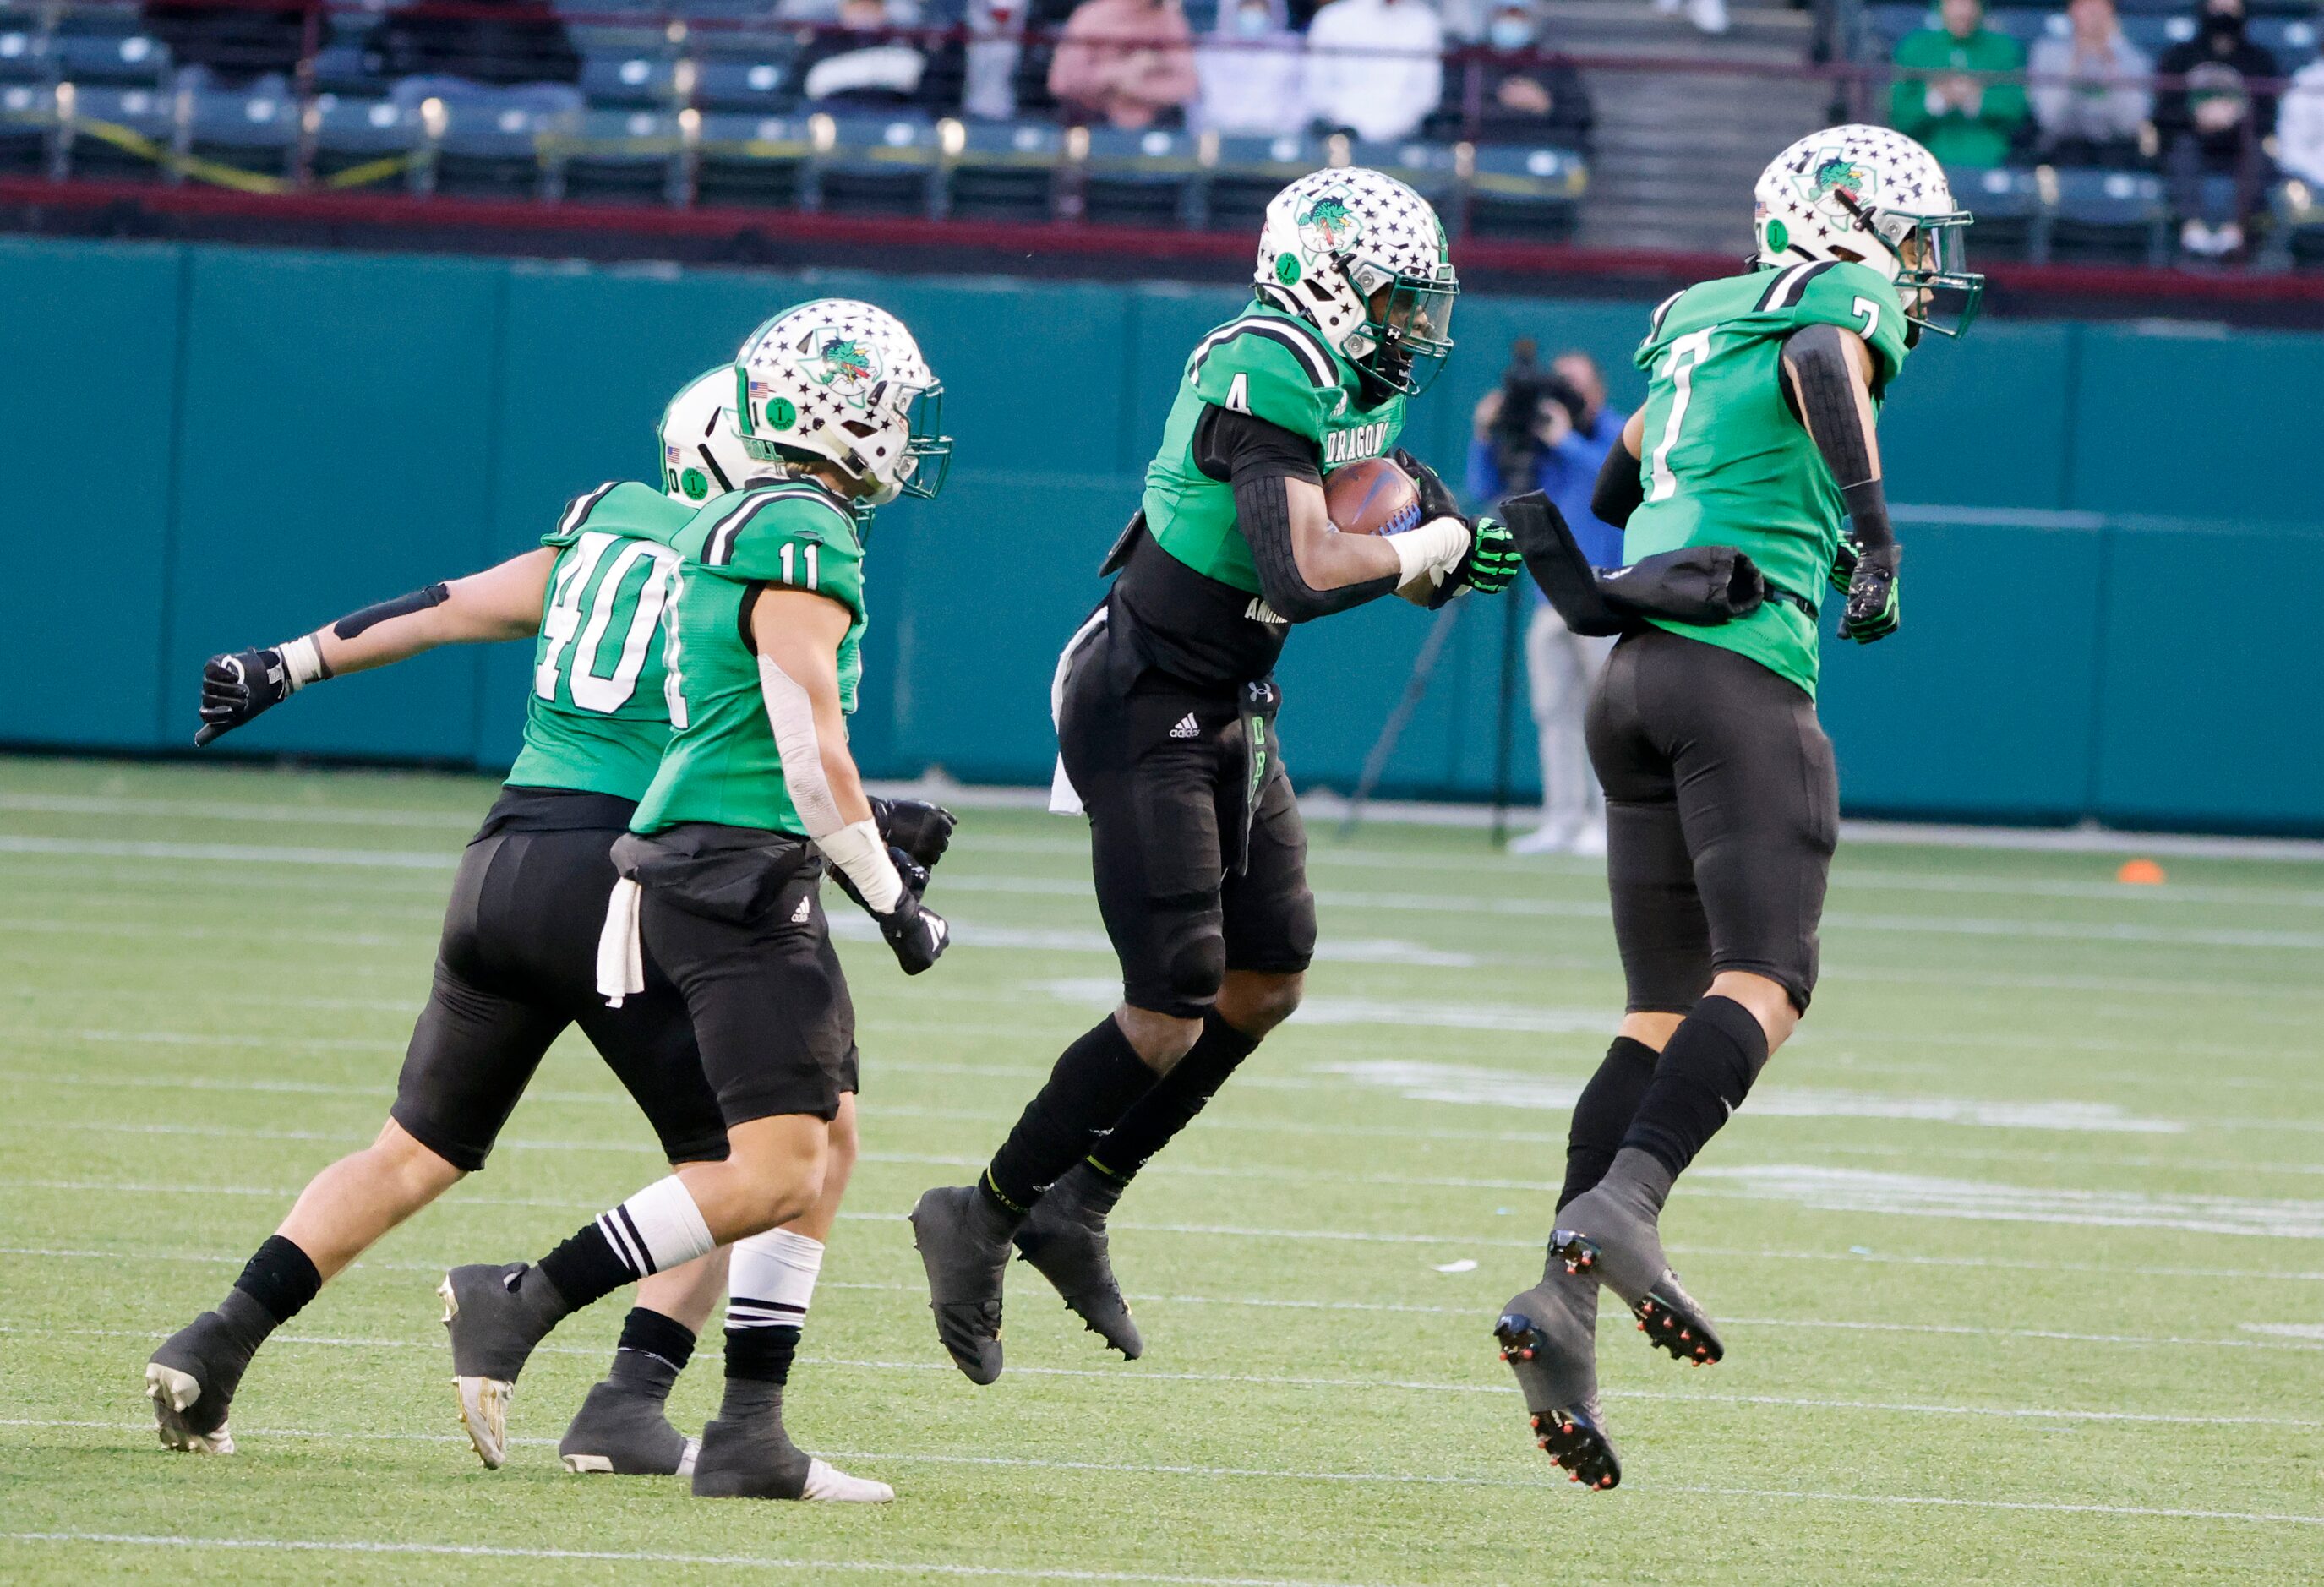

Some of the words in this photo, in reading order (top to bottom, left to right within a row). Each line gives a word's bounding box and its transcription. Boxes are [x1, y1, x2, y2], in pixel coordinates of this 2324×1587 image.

[1852, 295, 1881, 340] 7
[1225, 372, 1254, 416] 4
[1649, 324, 1720, 503] 7
[778, 541, 821, 590] 11
[534, 532, 679, 714] 40
